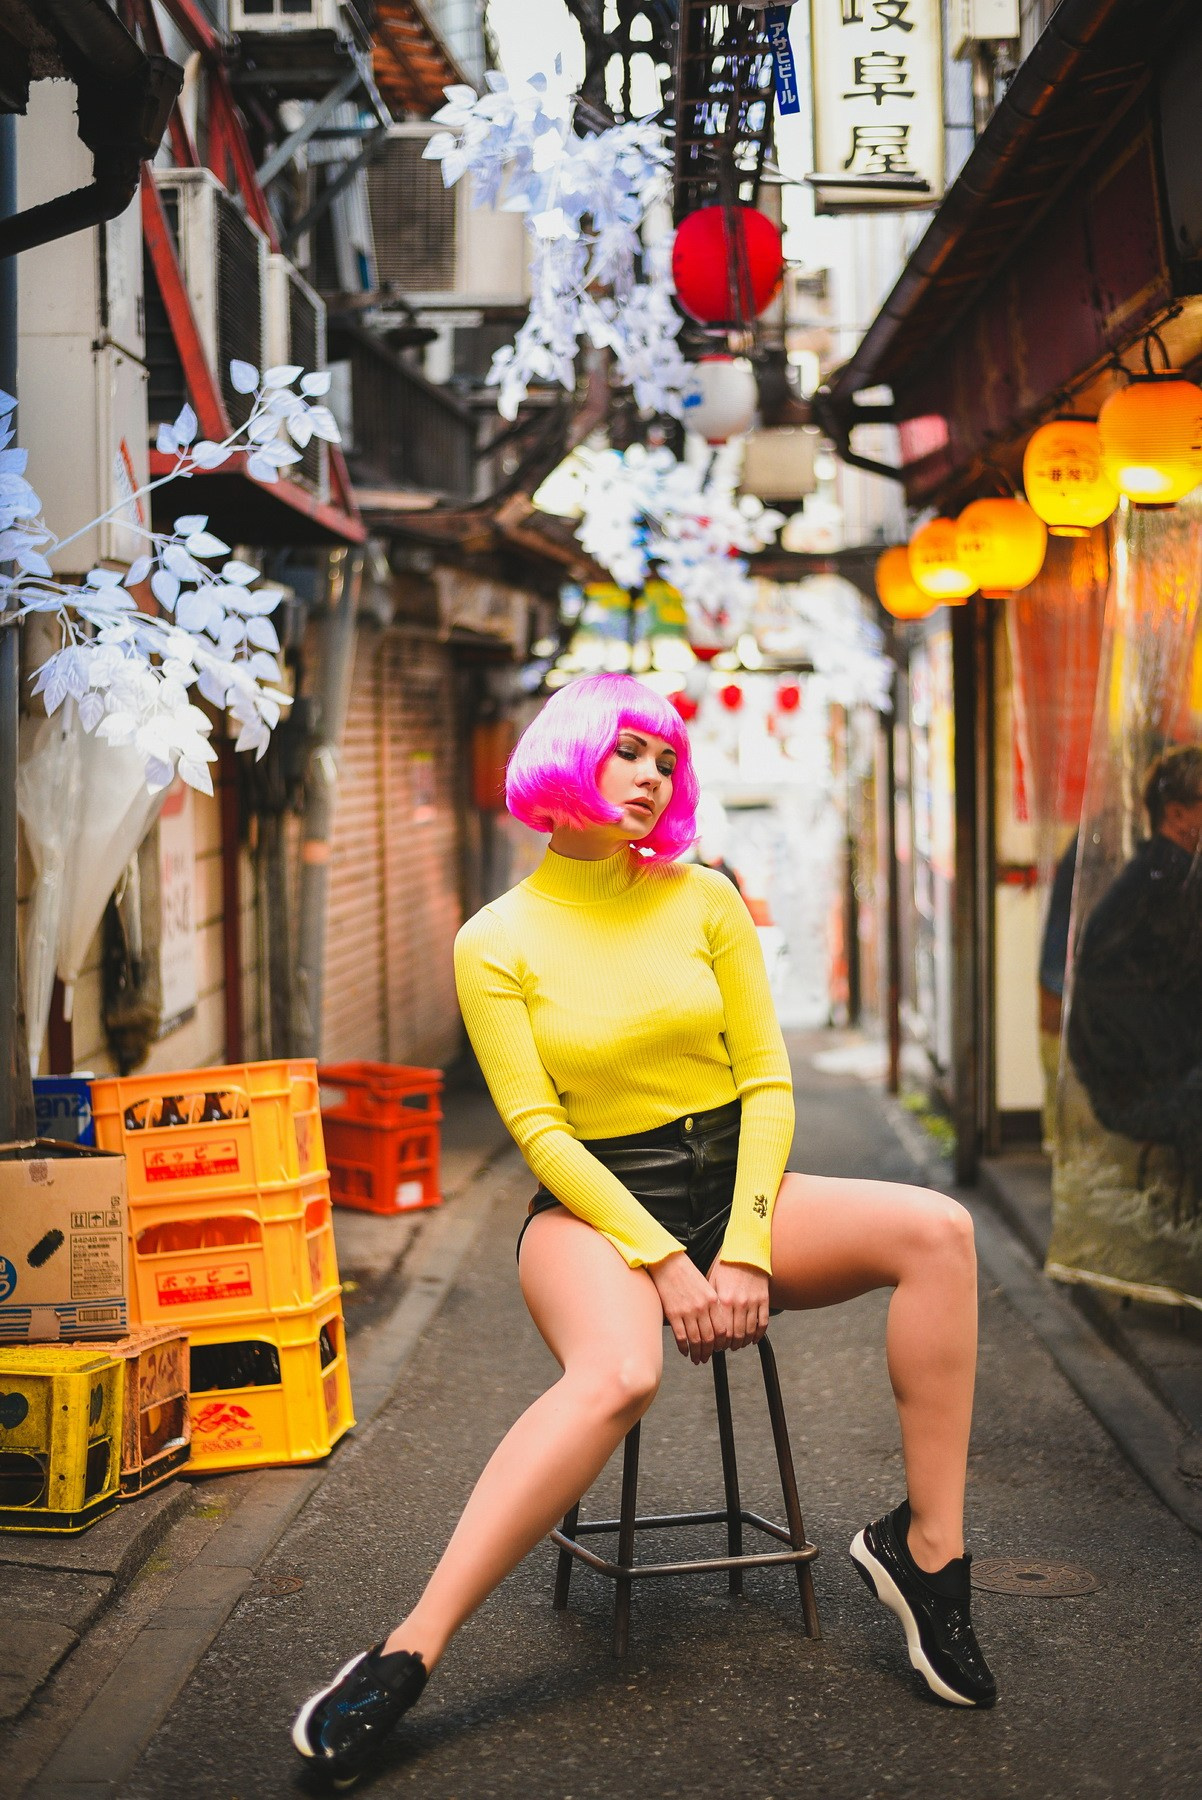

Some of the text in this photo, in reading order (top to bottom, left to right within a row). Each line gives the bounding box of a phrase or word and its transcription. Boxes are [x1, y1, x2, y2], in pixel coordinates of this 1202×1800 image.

[770, 22, 796, 105] アサヒビール
[150, 1144, 232, 1166] ホッピー
[162, 1269, 245, 1290] ホッピー
